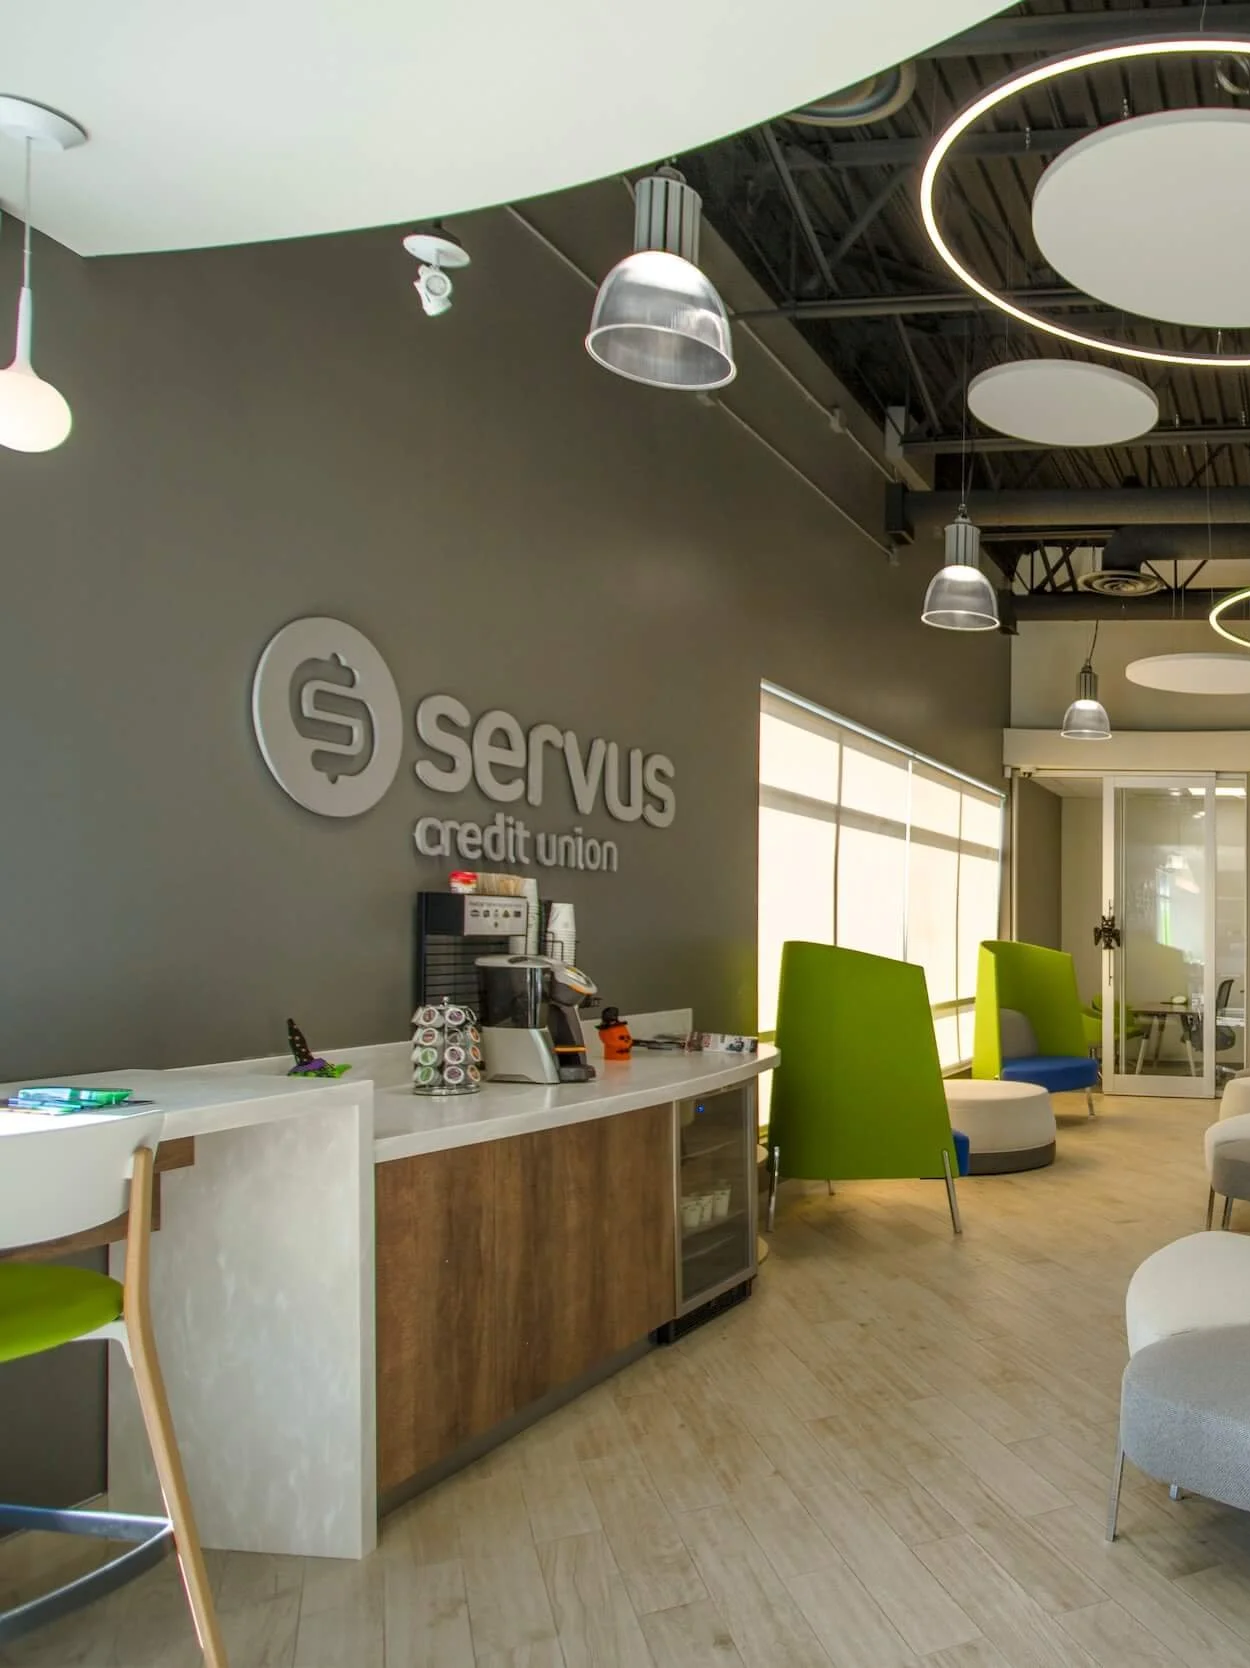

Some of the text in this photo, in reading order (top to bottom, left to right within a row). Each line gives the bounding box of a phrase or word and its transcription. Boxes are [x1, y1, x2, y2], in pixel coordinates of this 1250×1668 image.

[415, 694, 677, 828] servus
[414, 812, 619, 872] credit union
